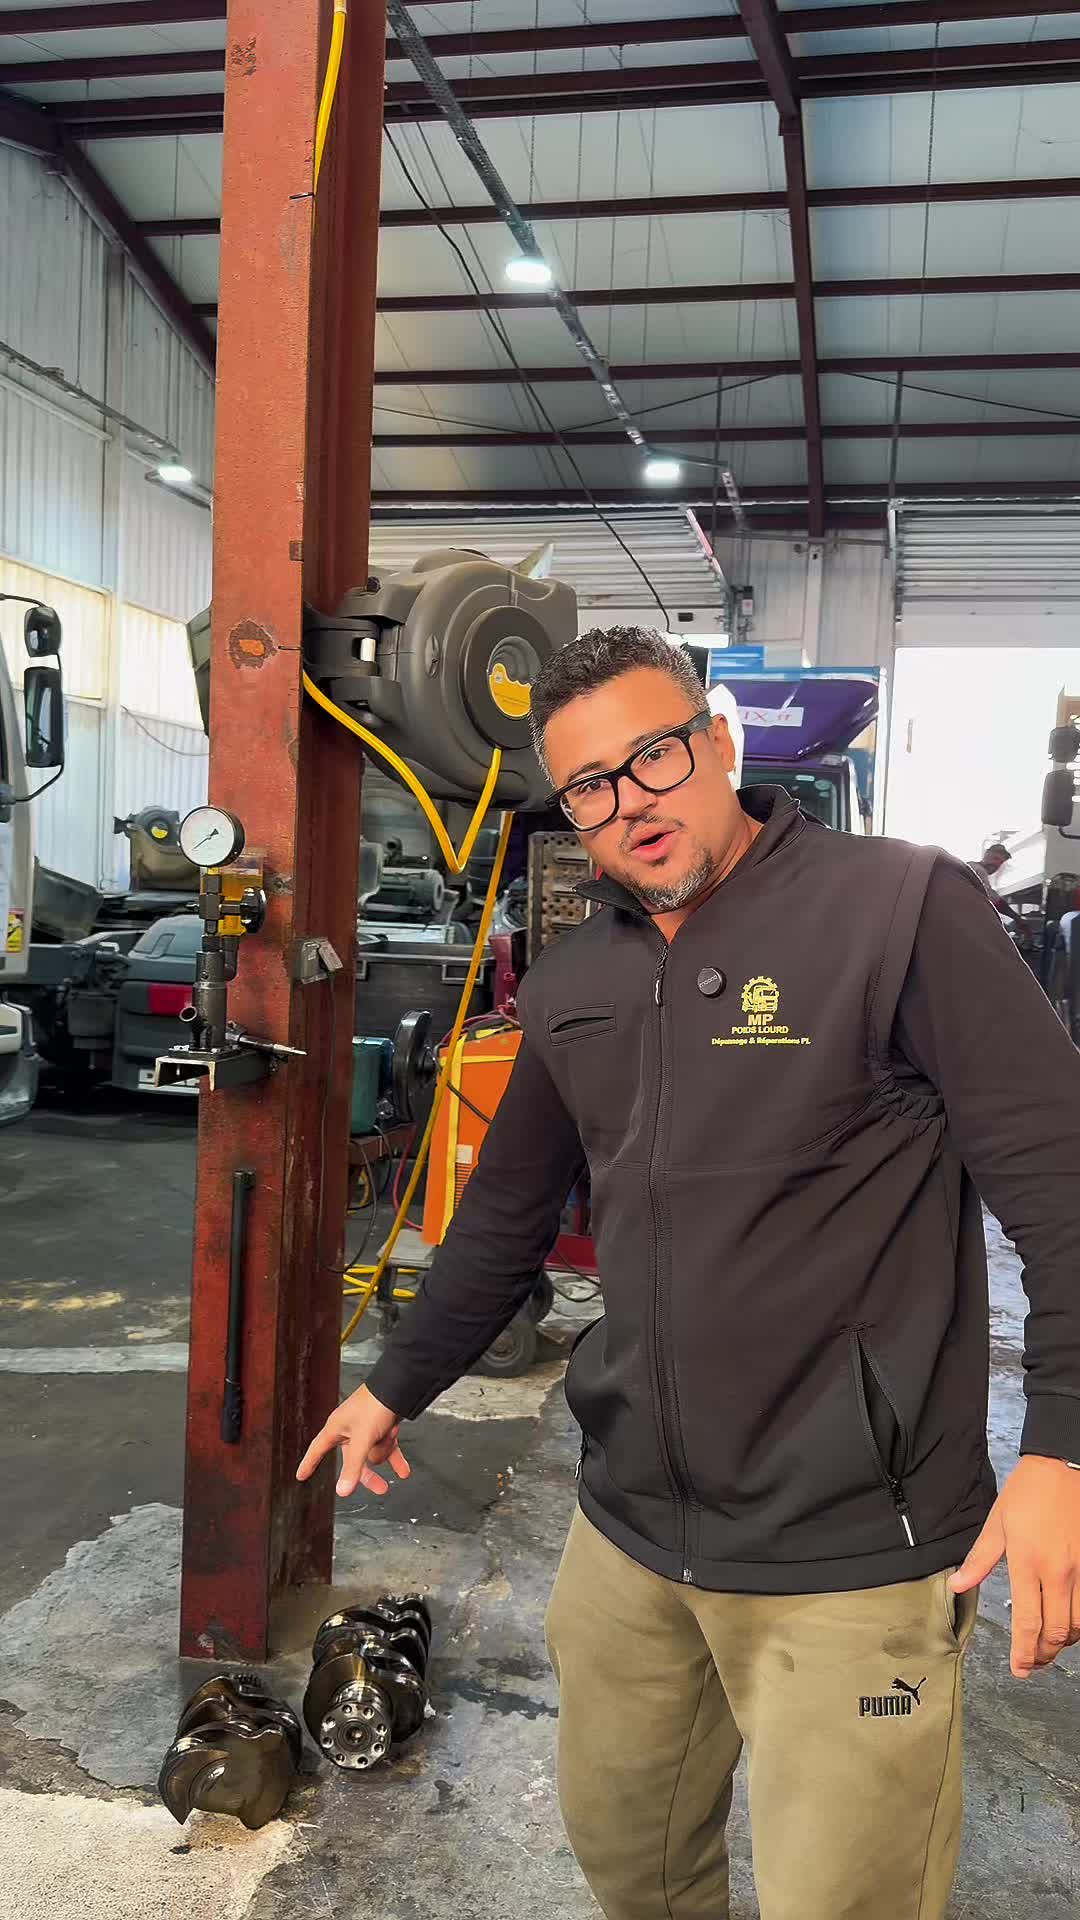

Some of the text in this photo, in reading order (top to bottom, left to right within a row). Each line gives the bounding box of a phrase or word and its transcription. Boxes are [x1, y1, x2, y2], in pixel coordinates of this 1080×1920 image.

[747, 1014, 774, 1026] MP
[731, 1026, 789, 1034] POIDS LOURD
[749, 1037, 756, 1045] &
[801, 1037, 811, 1045] PL
[859, 1695, 912, 1716] PUMA
